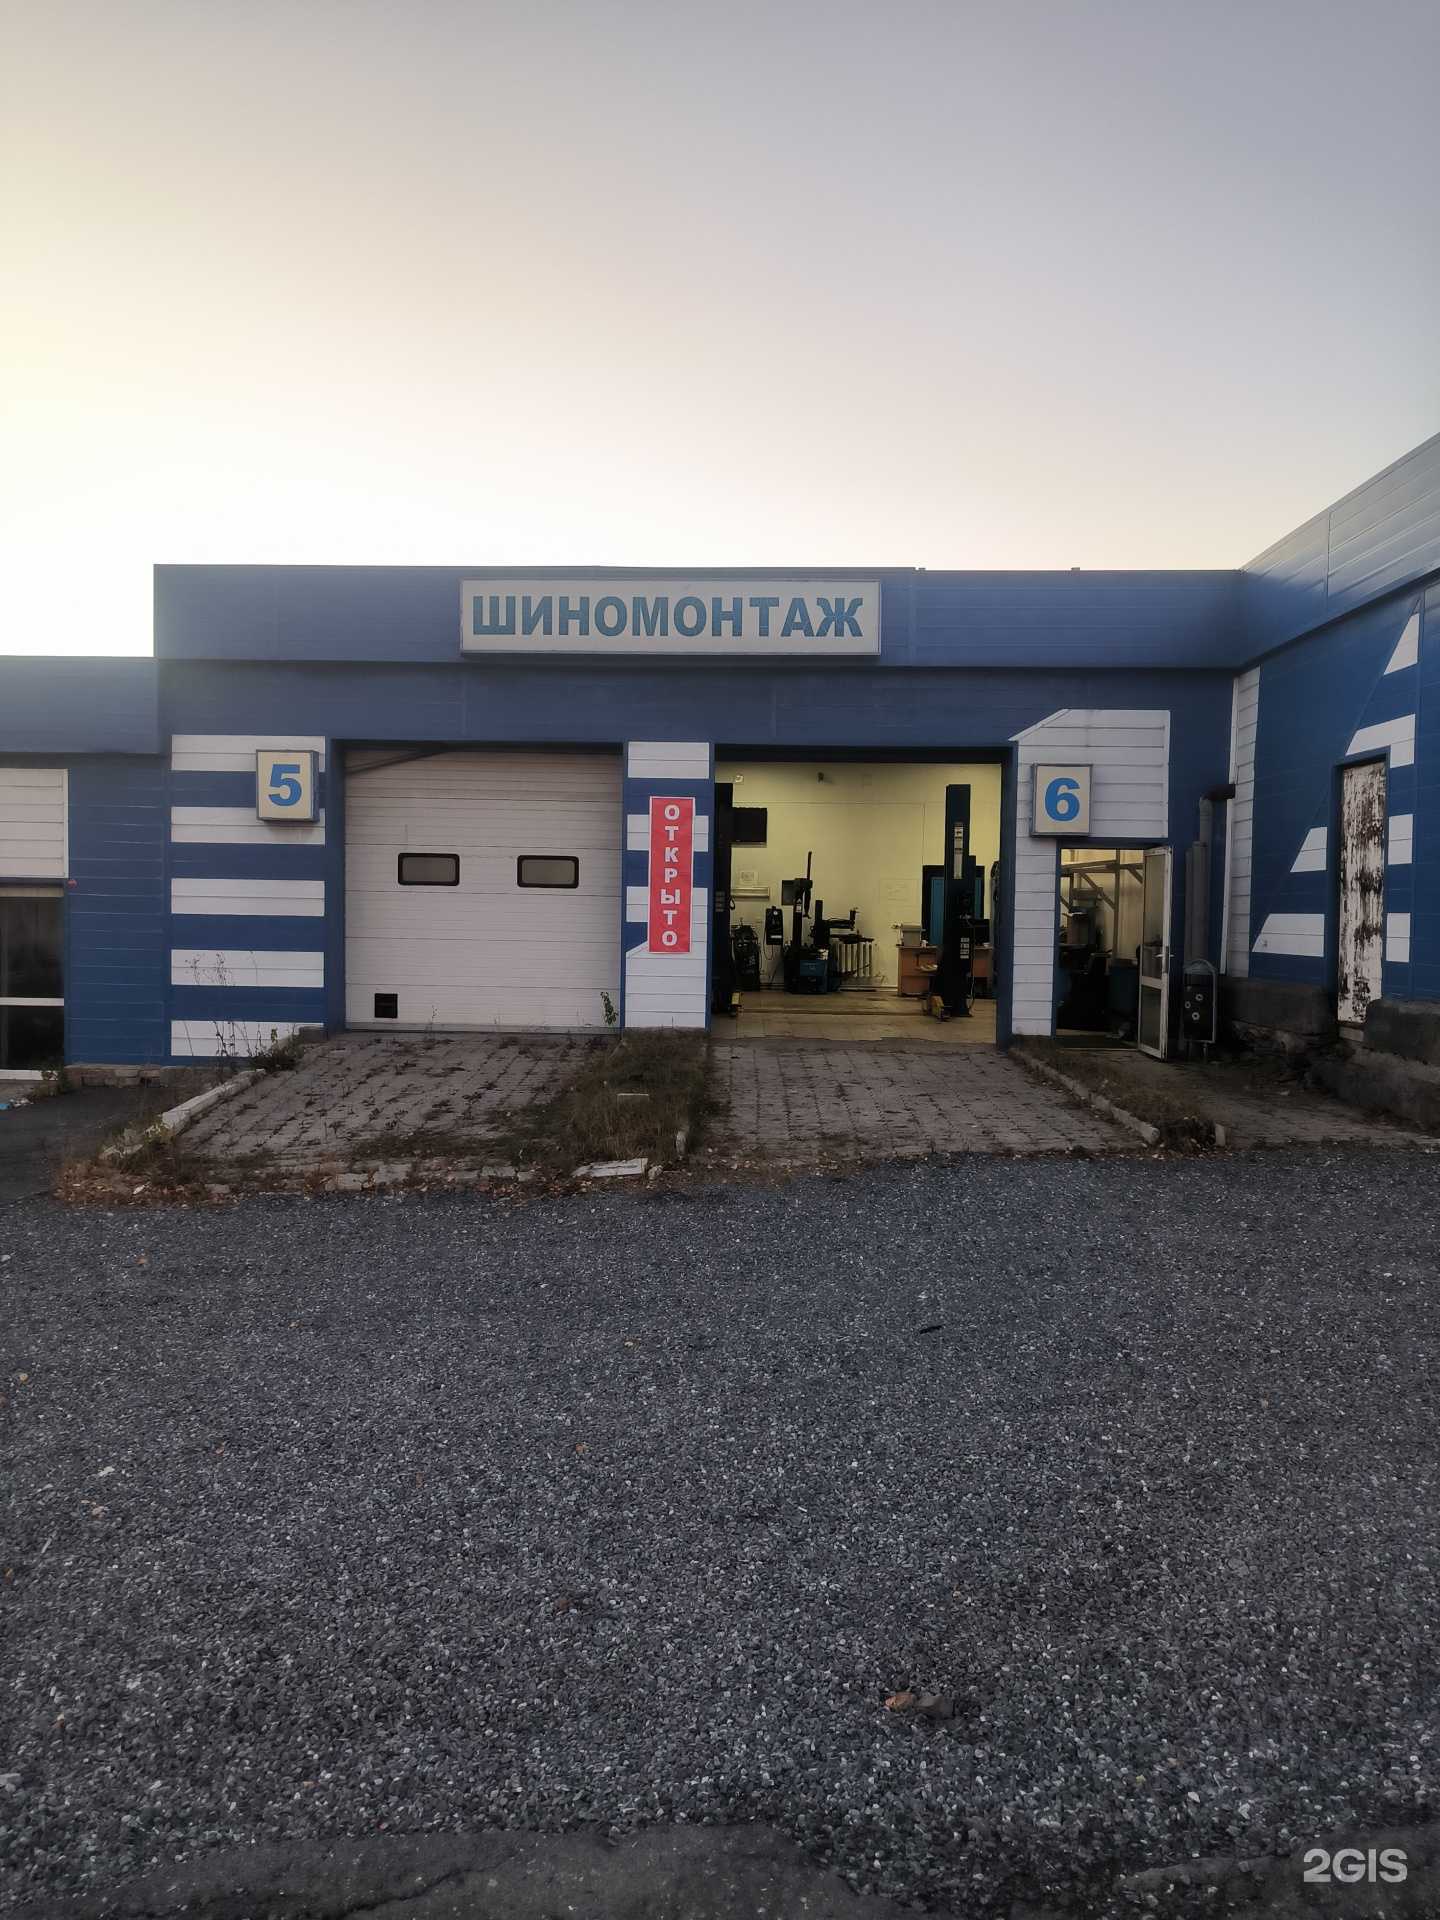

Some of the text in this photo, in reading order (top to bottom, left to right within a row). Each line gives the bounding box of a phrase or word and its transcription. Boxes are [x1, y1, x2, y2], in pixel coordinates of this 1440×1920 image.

[472, 595, 864, 638] ШИНОМОНТАЖ
[268, 763, 303, 807] 5
[1044, 777, 1081, 822] 6
[660, 804, 681, 947] ОТКРЫТО
